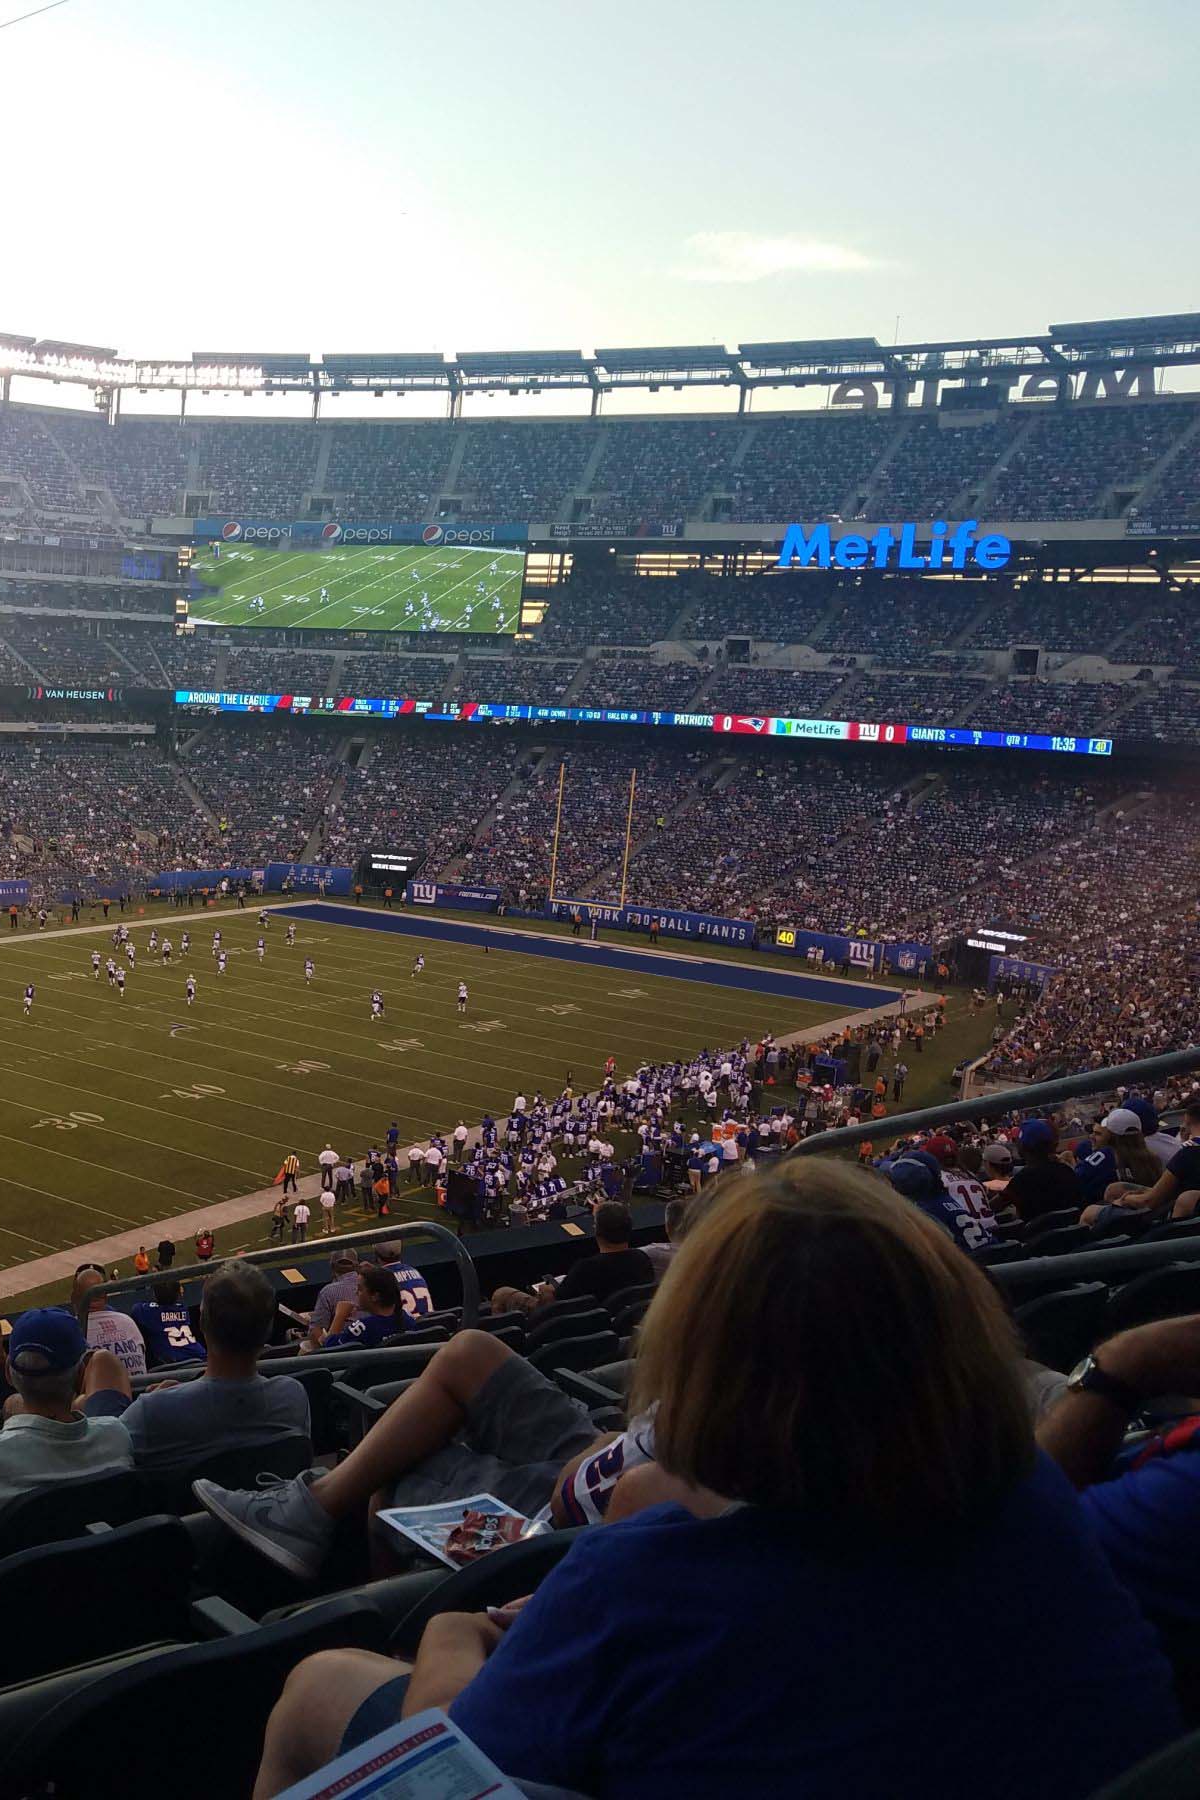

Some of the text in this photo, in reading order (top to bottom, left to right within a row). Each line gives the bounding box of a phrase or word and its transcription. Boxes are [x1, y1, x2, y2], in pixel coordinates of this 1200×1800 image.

[244, 525, 292, 542] pepsi
[343, 524, 392, 542] pepsi
[442, 526, 494, 546] pepsi
[776, 519, 1011, 568] MetLife
[45, 689, 105, 700] VAN HEUSEN
[187, 691, 270, 706] AROUND THE LEAGUE
[674, 713, 713, 727] PATRIOTS
[722, 716, 732, 730] 0
[795, 723, 841, 736] MetLife
[858, 723, 880, 741] ny
[885, 725, 895, 741] 0
[911, 728, 946, 741] GIANTS
[1006, 735, 1028, 746] QTR 1
[1051, 737, 1076, 751] 11:35
[1095, 742, 1107, 752] 40
[412, 883, 437, 904] ny
[588, 906, 620, 922] YORK
[698, 922, 746, 941] GIANTS
[778, 931, 794, 944] 40
[977, 928, 1028, 942] verizon
[849, 941, 875, 967] ny
[899, 958, 914, 970] NFL
[171, 1082, 226, 1100] 40
[43, 1110, 106, 1131] 30
[161, 1311, 190, 1322] BARKLE
